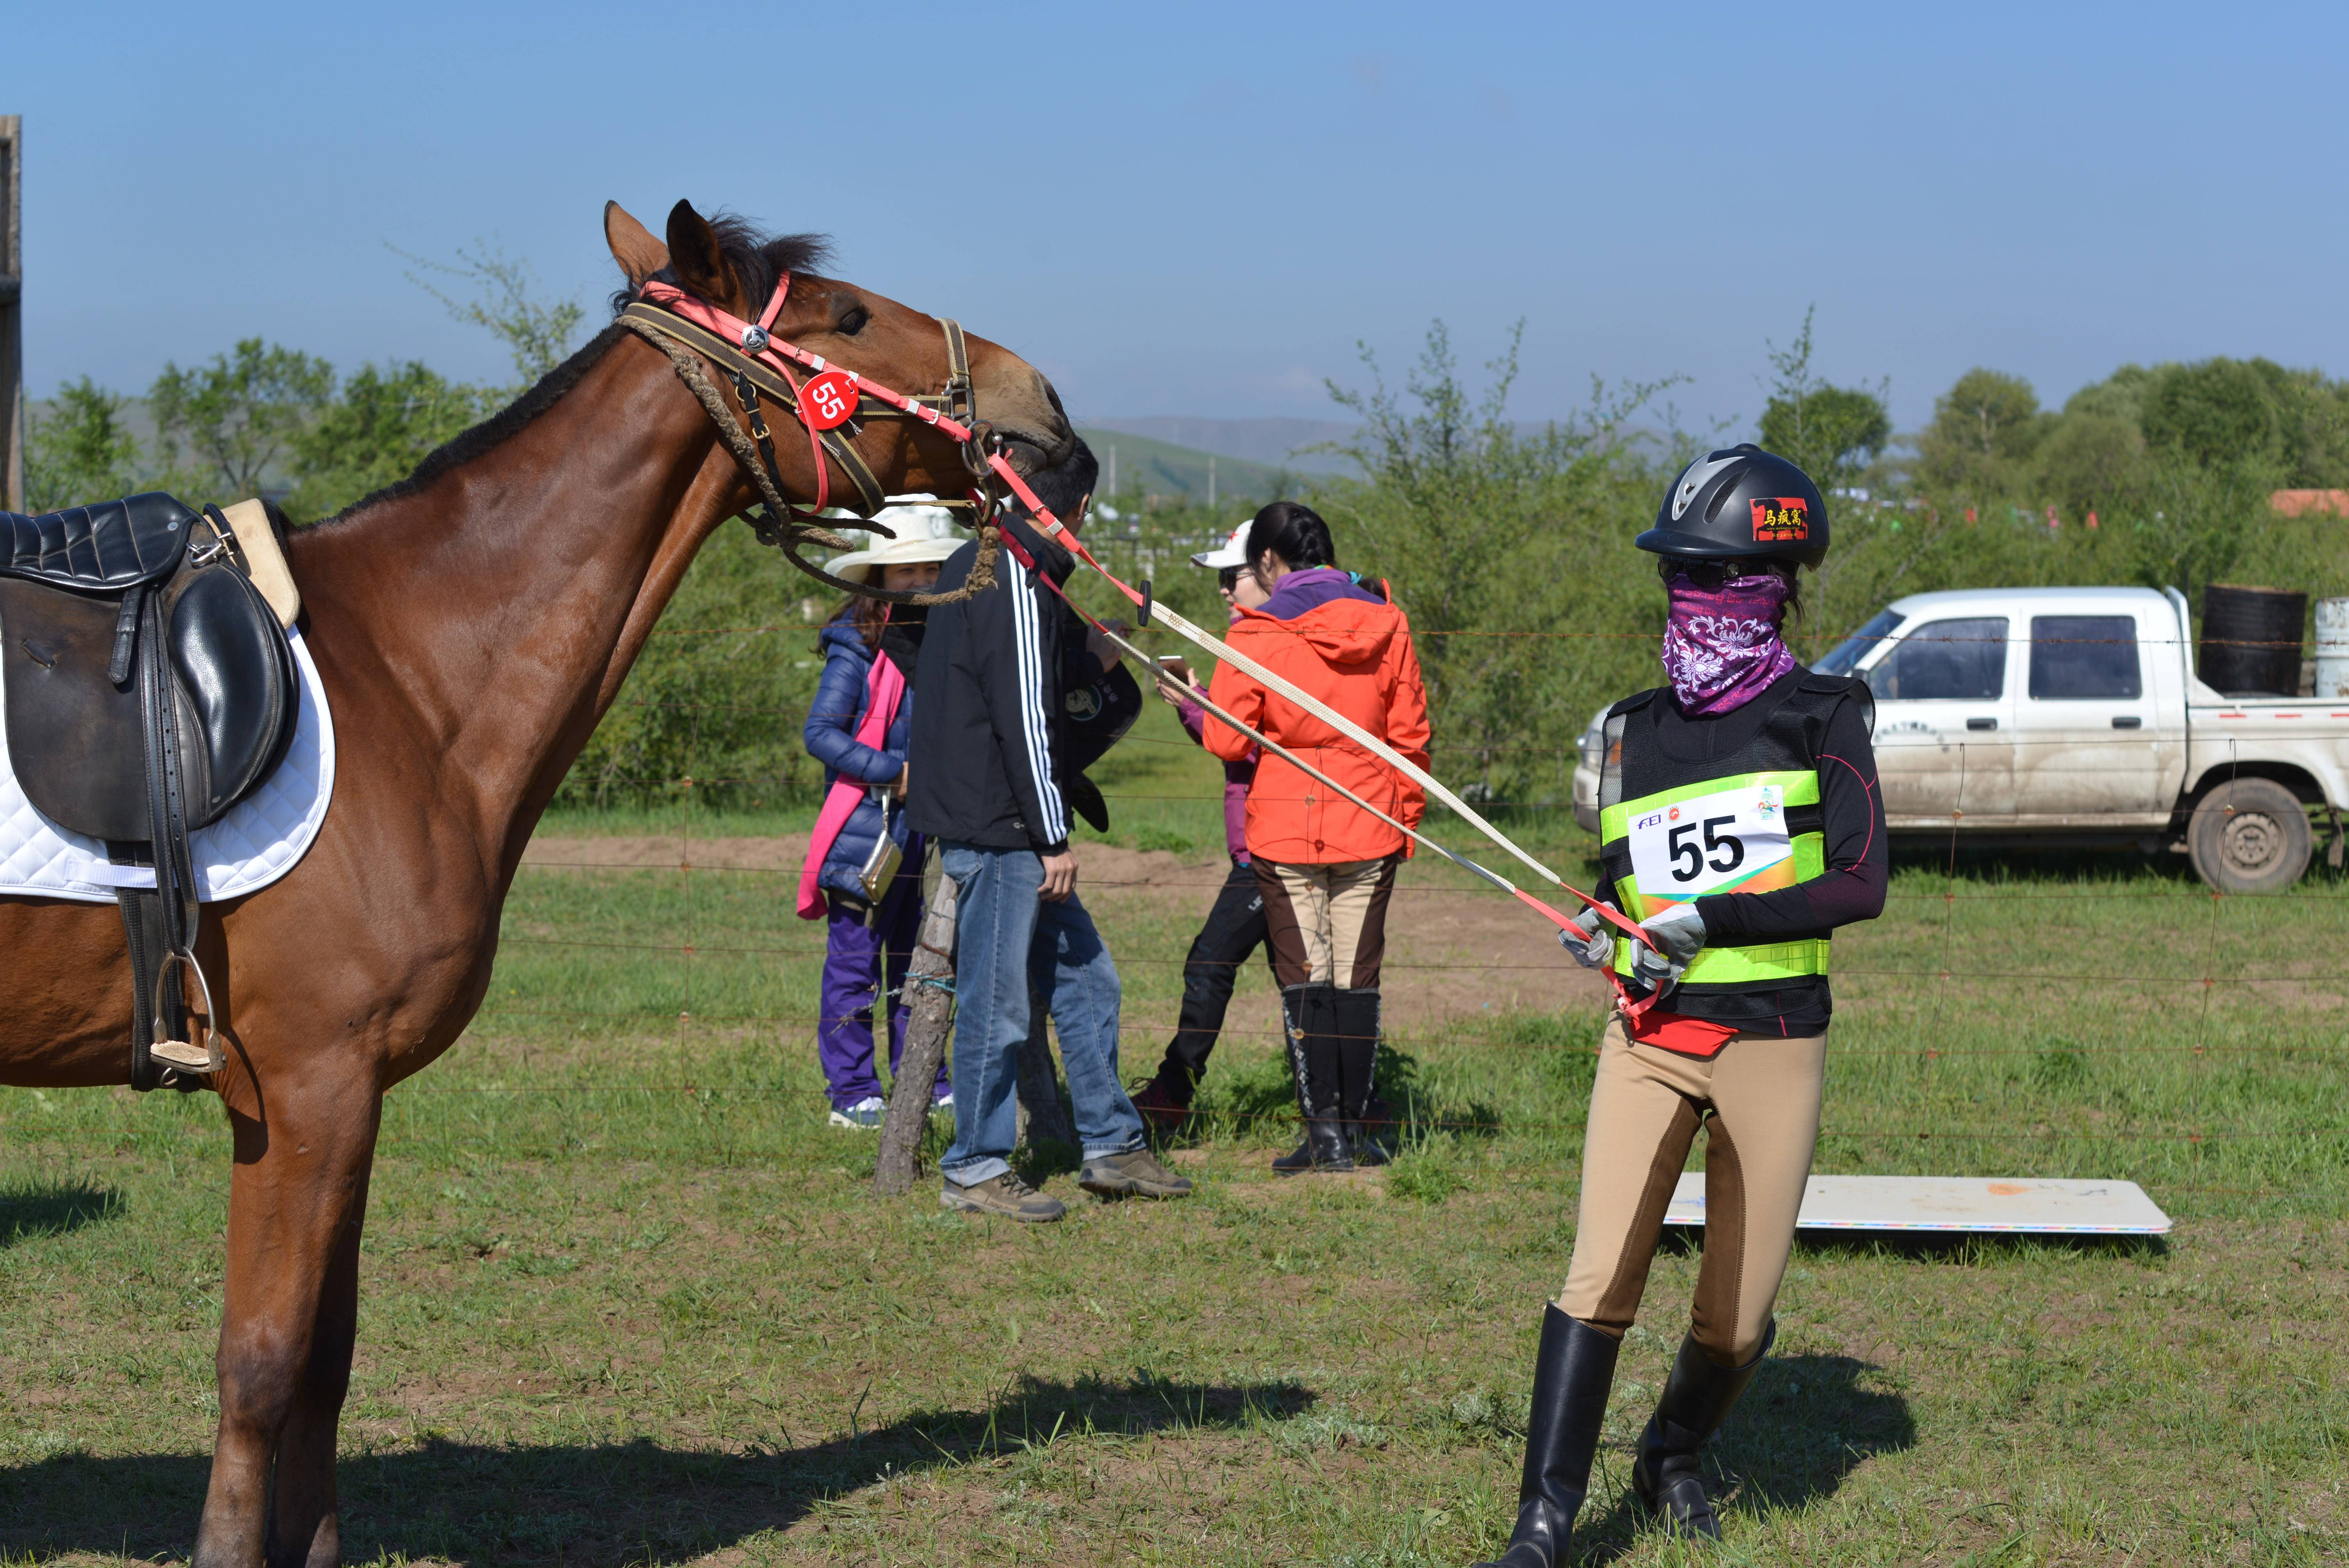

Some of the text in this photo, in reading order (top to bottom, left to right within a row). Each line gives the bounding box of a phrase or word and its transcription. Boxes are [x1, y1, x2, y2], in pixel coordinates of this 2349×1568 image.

[812, 381, 846, 419] 55
[1764, 509, 1801, 526] 马疯窝
[1637, 814, 1661, 830] FEI
[1669, 815, 1744, 882] 55
